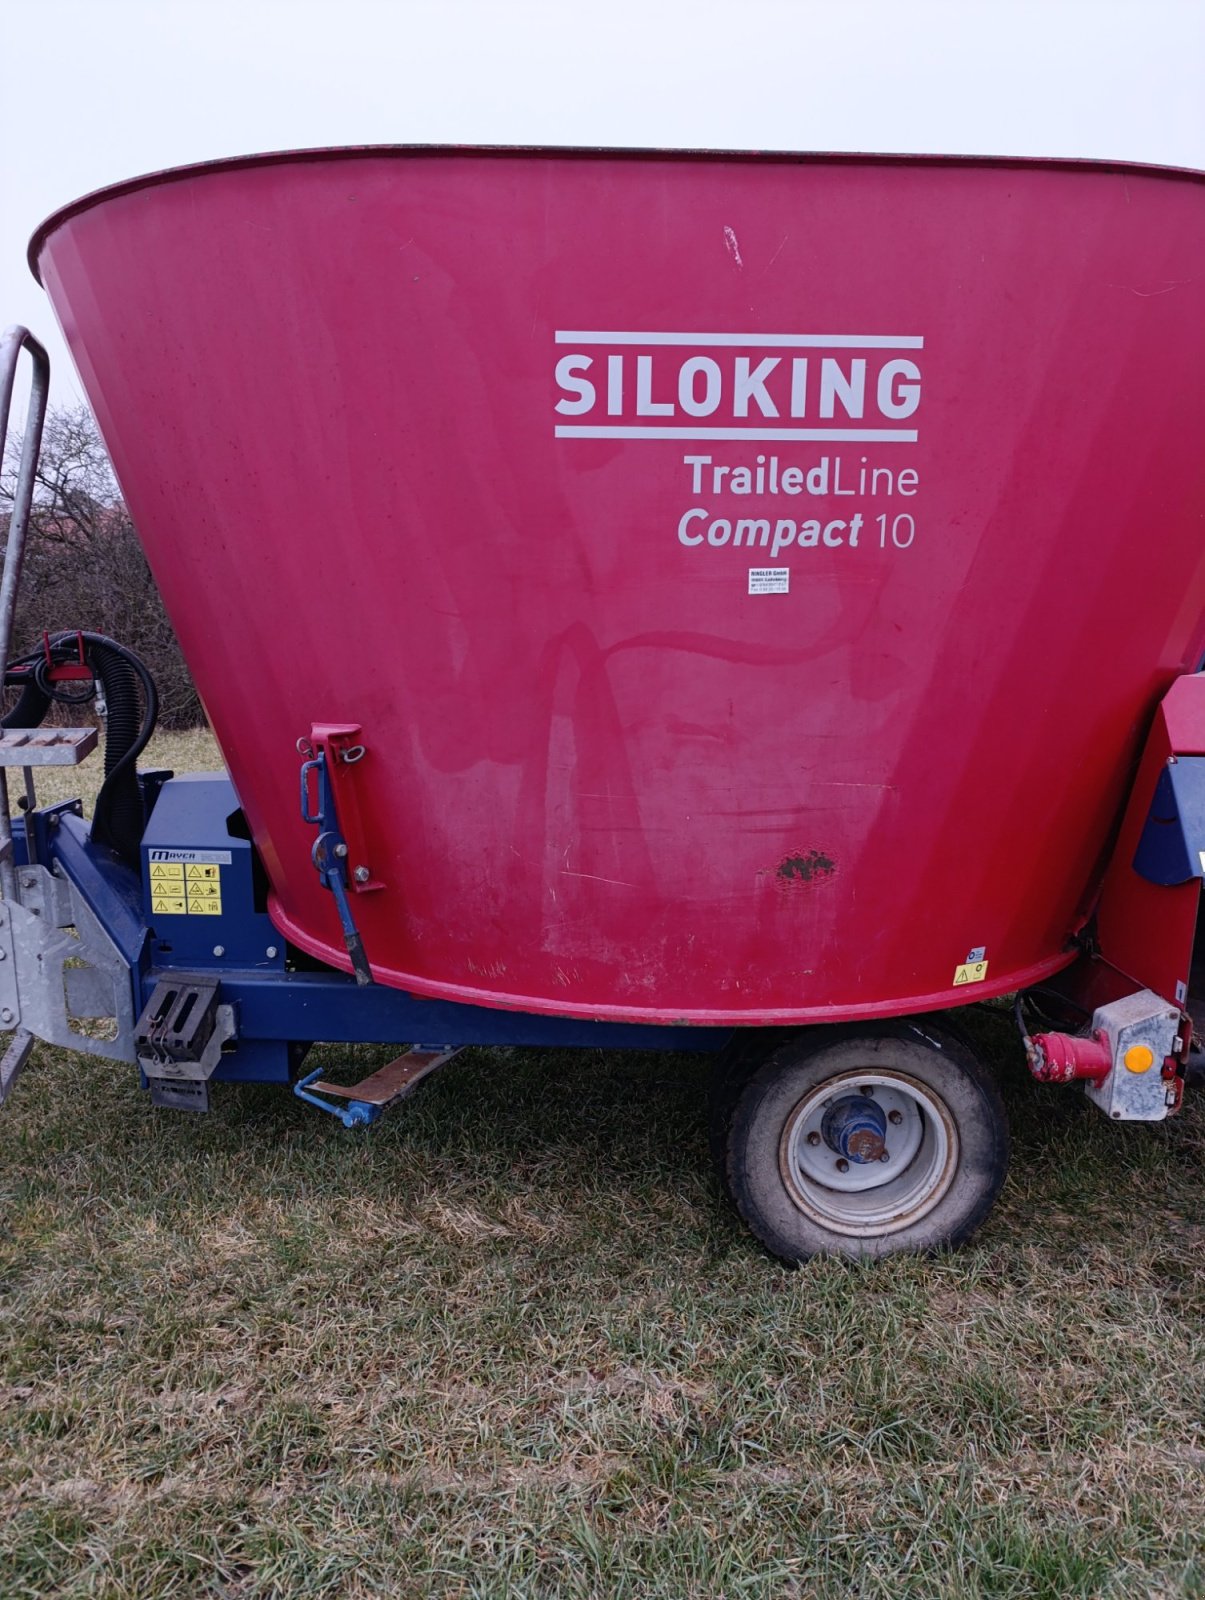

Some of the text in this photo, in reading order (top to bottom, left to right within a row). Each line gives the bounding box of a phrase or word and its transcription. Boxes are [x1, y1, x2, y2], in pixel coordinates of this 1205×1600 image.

[554, 353, 922, 419] SILOKING
[683, 455, 919, 496] TrailedLine
[677, 508, 915, 558] Compact 10
